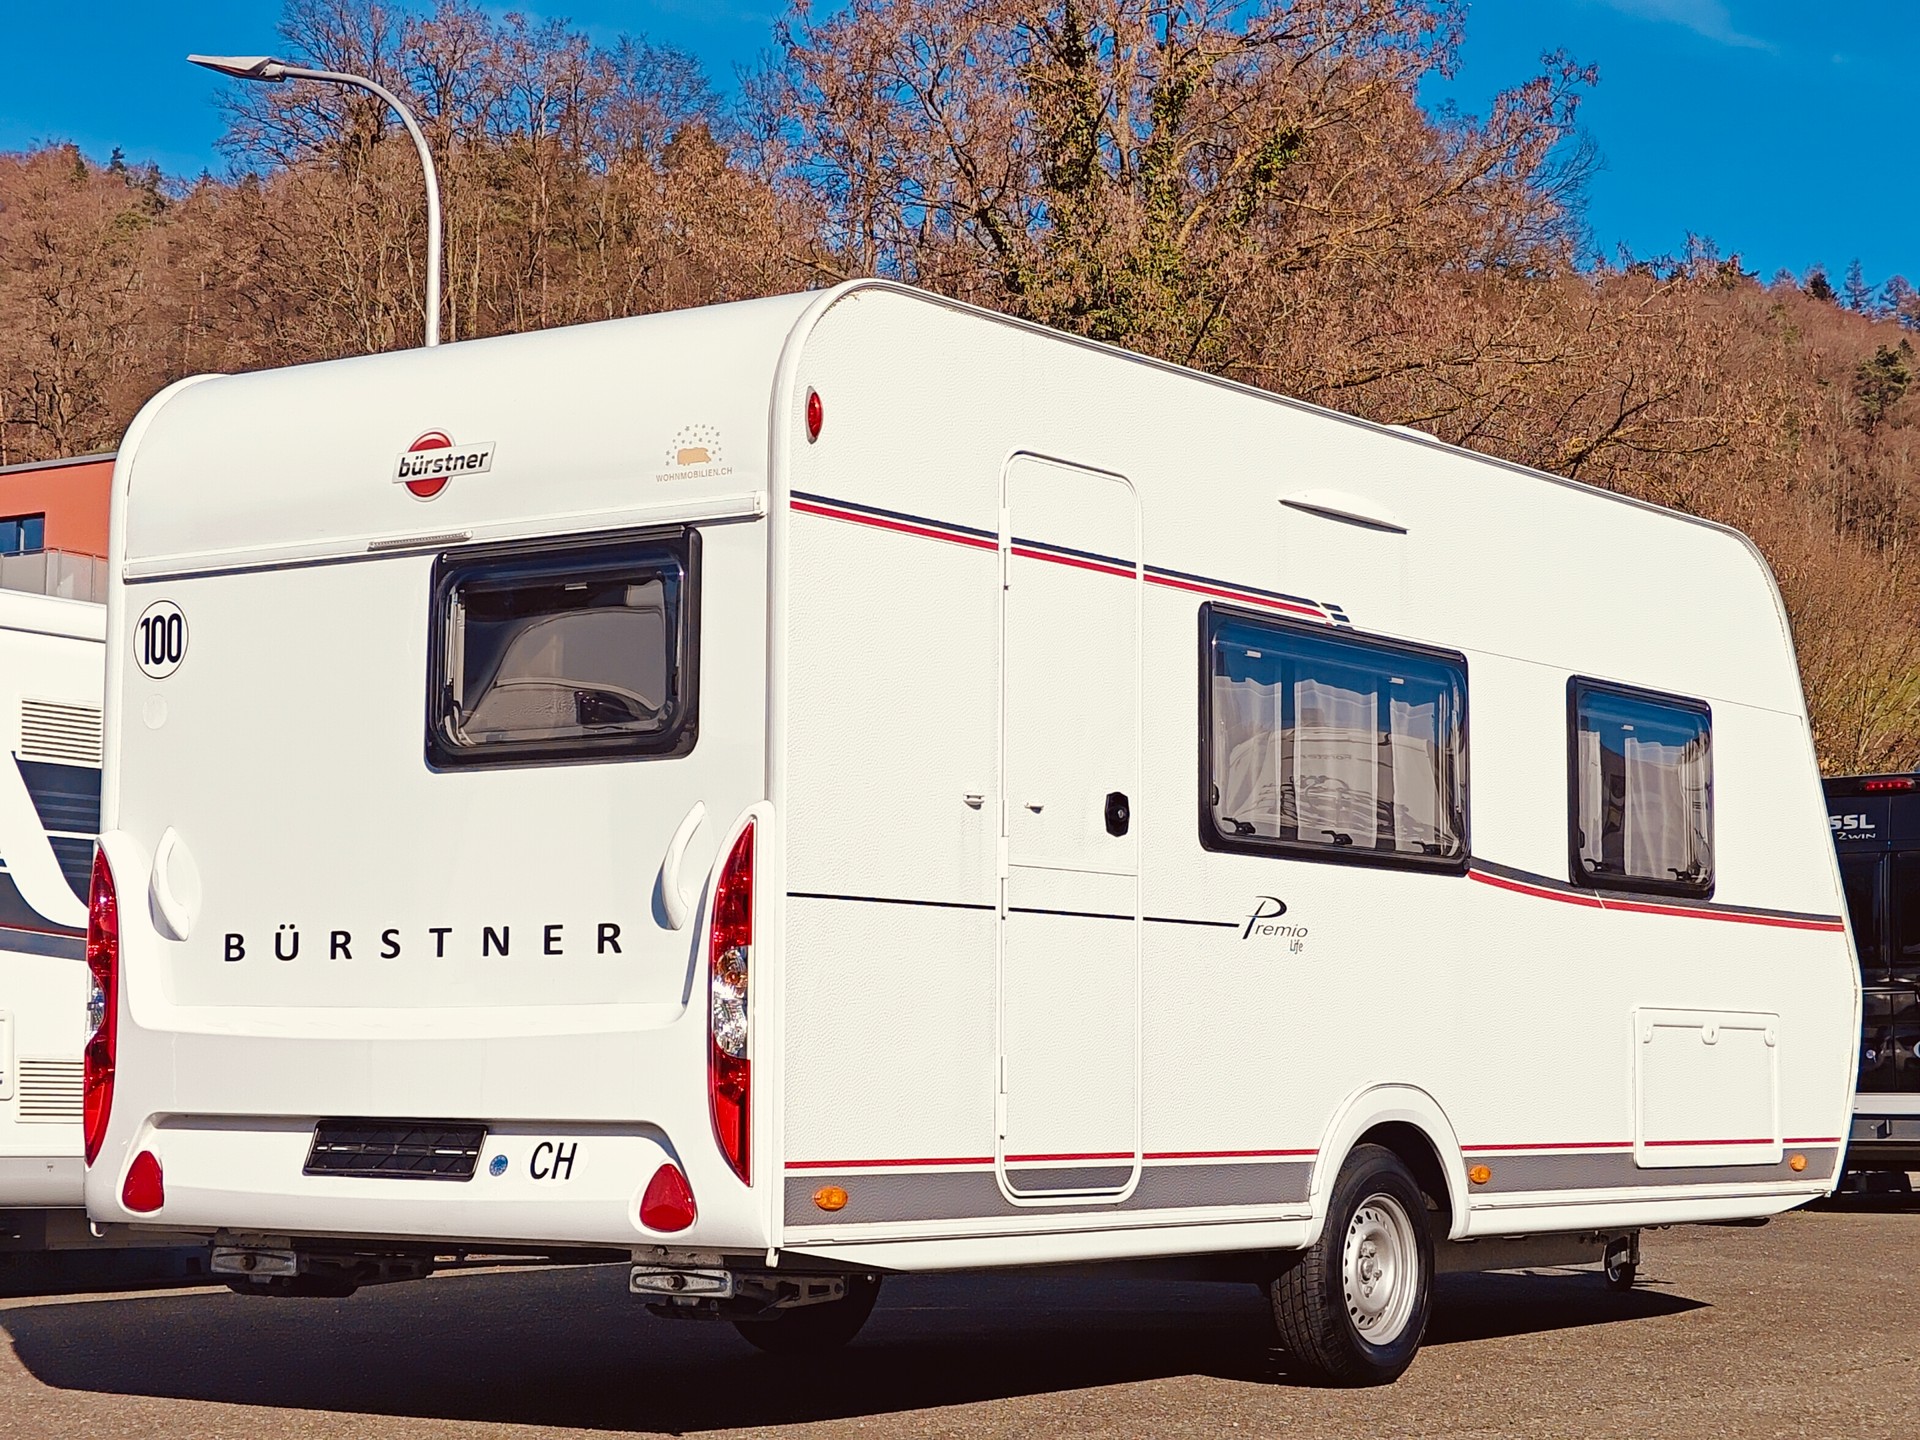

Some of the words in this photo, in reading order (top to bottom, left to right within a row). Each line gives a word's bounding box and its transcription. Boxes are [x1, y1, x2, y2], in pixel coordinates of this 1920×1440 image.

[398, 452, 489, 478] bürstner
[655, 467, 733, 482] WOHNMOBILIEN.CH
[140, 613, 182, 665] 100
[1242, 895, 1308, 940] Premio
[224, 923, 622, 962] BÜRSTNER
[1289, 939, 1304, 955] Life
[529, 1141, 578, 1180] CH
